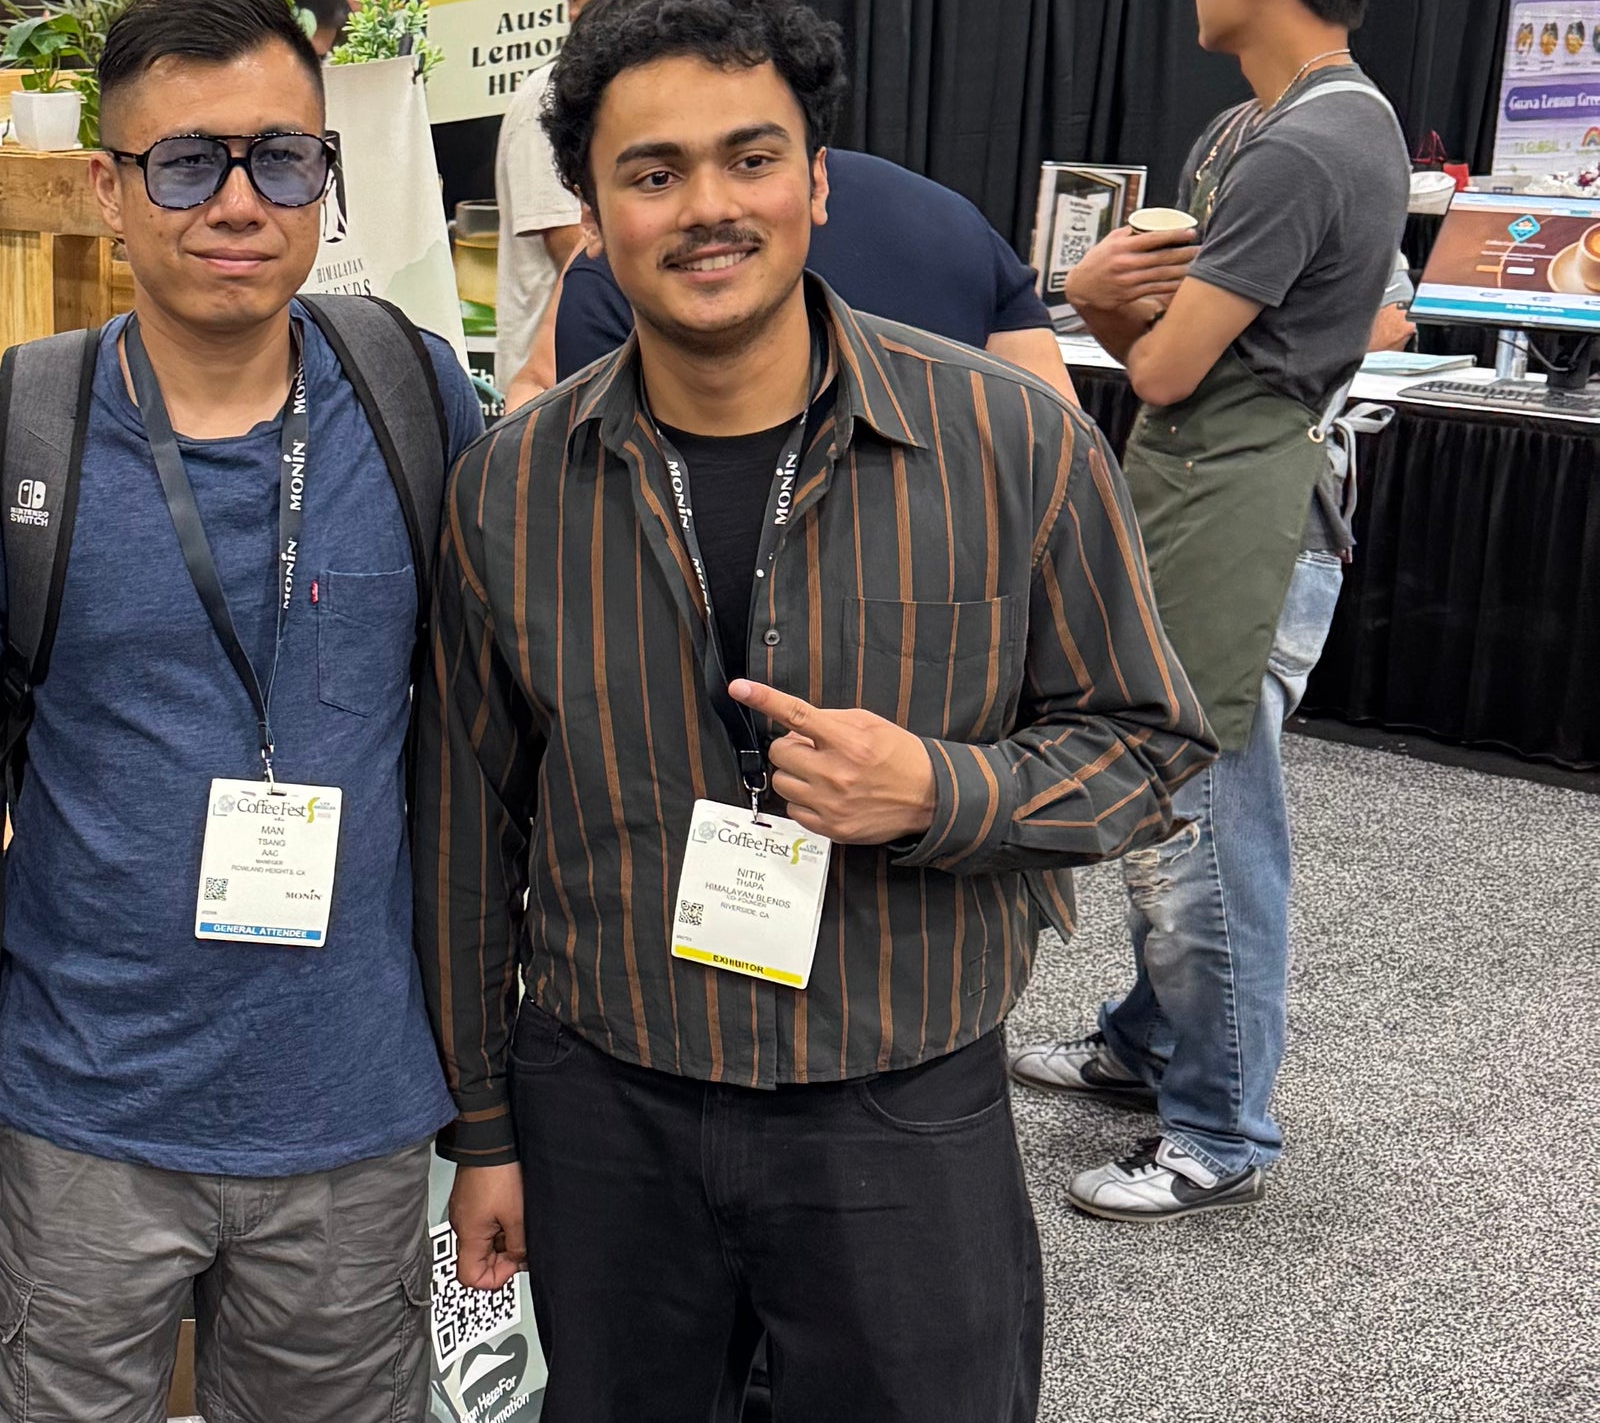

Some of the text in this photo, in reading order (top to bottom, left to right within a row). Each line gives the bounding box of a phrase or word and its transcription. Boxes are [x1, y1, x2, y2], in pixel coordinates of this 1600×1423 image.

[316, 258, 364, 284] HIMALAYAN
[10, 513, 49, 527] SWITCH
[261, 825, 285, 836] MAN
[258, 838, 286, 848] TSANG
[261, 849, 279, 857] AAC
[737, 867, 766, 882] NITIK
[736, 878, 764, 891] THAPA
[705, 882, 791, 909] HIMALAYAN BLENDS
[759, 911, 770, 919] CA
[213, 924, 308, 938] GENERAL ATTENDEE
[712, 953, 764, 975] EXHIBITOR
